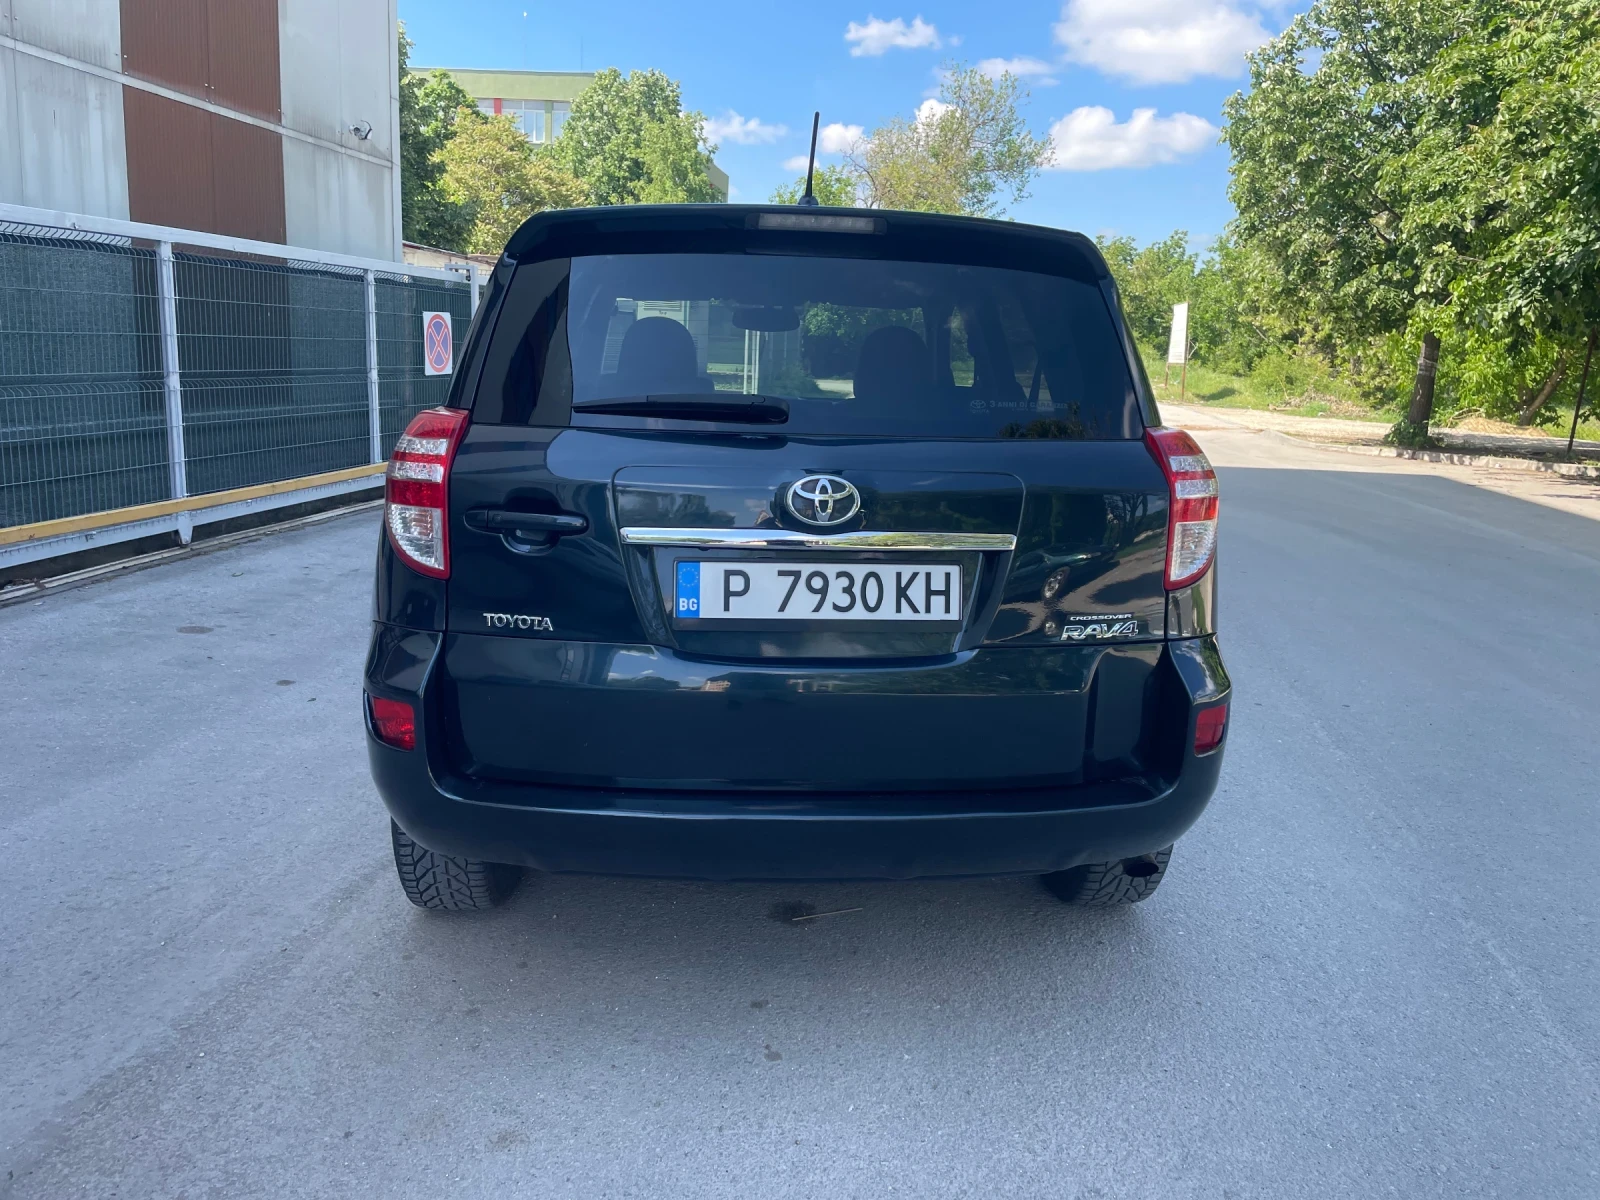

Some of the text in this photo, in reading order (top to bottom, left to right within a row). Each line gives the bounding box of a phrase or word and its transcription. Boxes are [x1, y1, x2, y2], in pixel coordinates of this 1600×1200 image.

[989, 400, 996, 408] 3
[724, 569, 951, 614] P 7930 KH
[679, 598, 698, 611] BG
[483, 612, 553, 631] TOYOTA
[1070, 613, 1132, 621] CROSSOVER
[1060, 620, 1138, 640] RAV4
